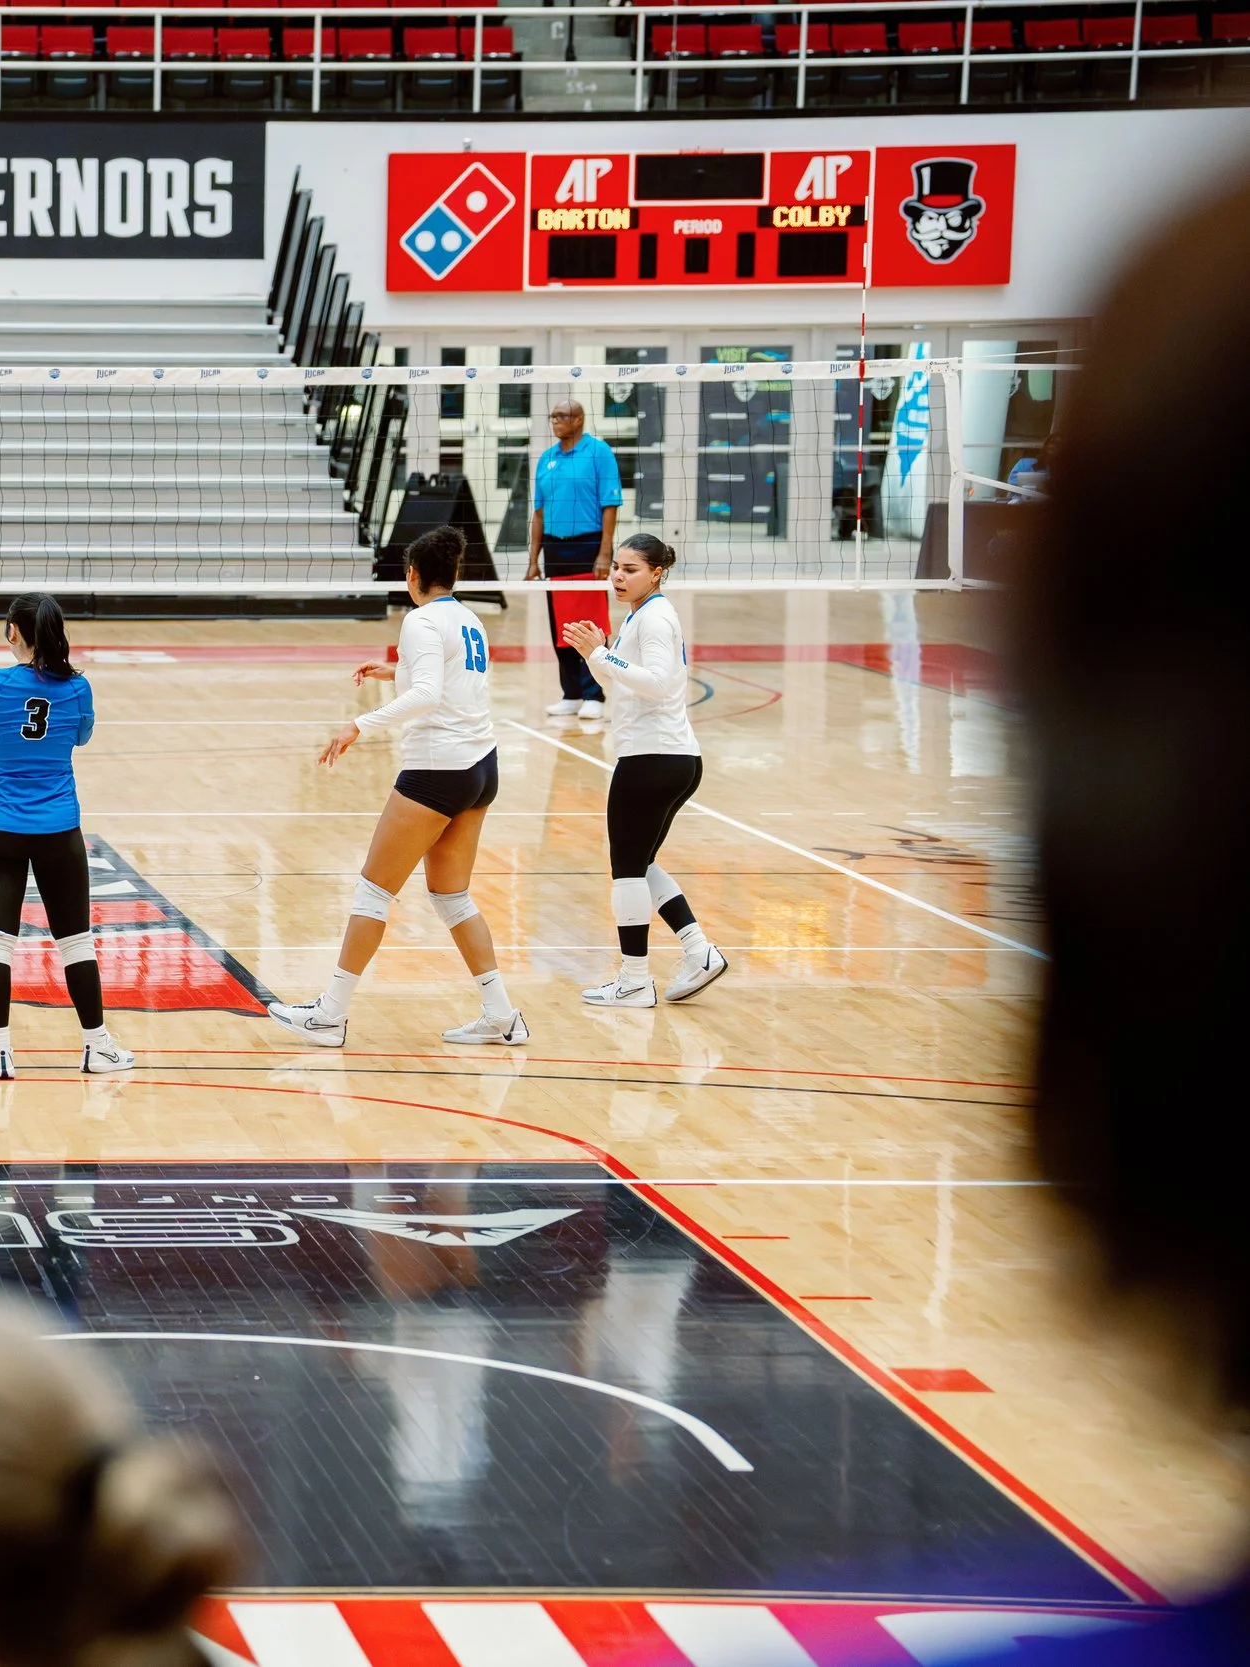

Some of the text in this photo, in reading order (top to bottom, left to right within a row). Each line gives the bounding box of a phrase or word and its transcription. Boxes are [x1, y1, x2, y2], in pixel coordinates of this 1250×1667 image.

[555, 158, 613, 203] AP
[794, 155, 853, 201] AP
[537, 208, 630, 230] BARTON
[673, 219, 723, 234] PERIOD
[772, 205, 851, 227] COLBY
[461, 625, 488, 673] 13
[20, 697, 52, 740] 3
